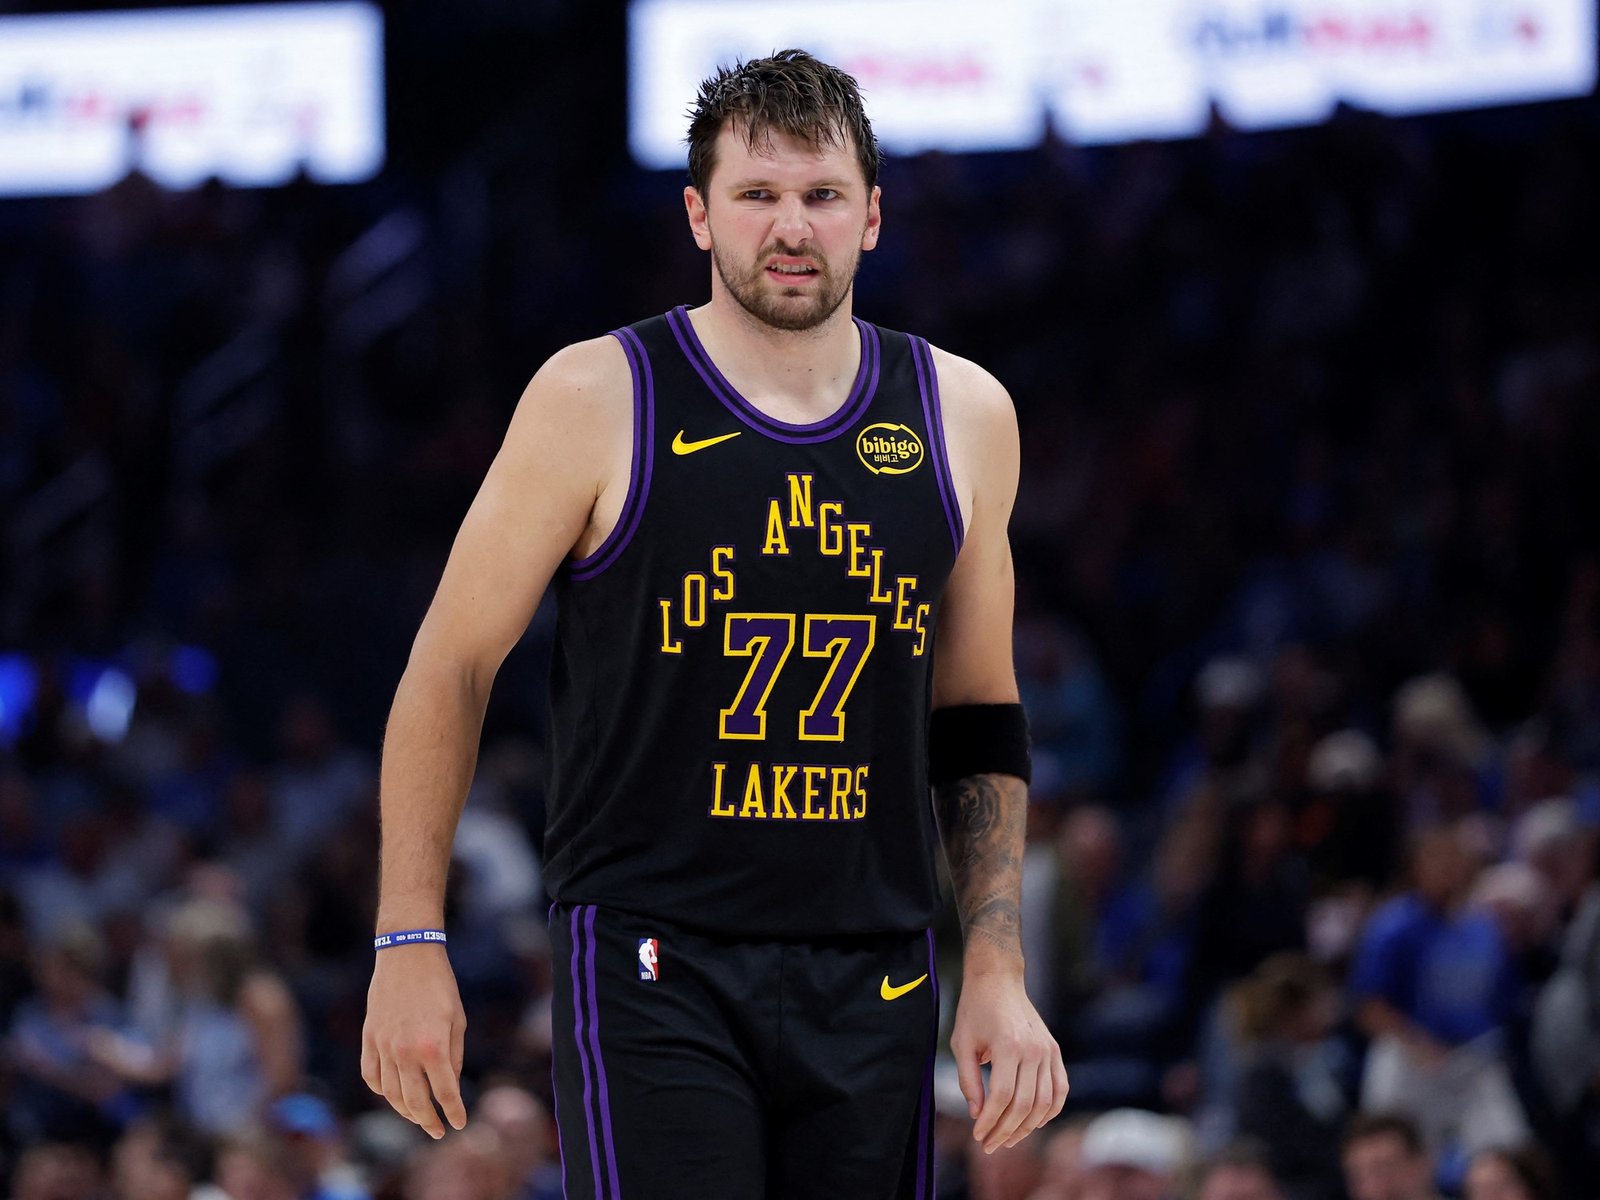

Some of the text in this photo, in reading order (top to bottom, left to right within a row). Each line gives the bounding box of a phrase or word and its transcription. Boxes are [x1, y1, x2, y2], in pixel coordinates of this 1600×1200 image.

[862, 436, 919, 459] bibigo
[873, 454, 899, 463] 비비고
[657, 473, 931, 658] LOS ANGELES
[718, 611, 878, 743] 77
[709, 762, 870, 821] LAKERS
